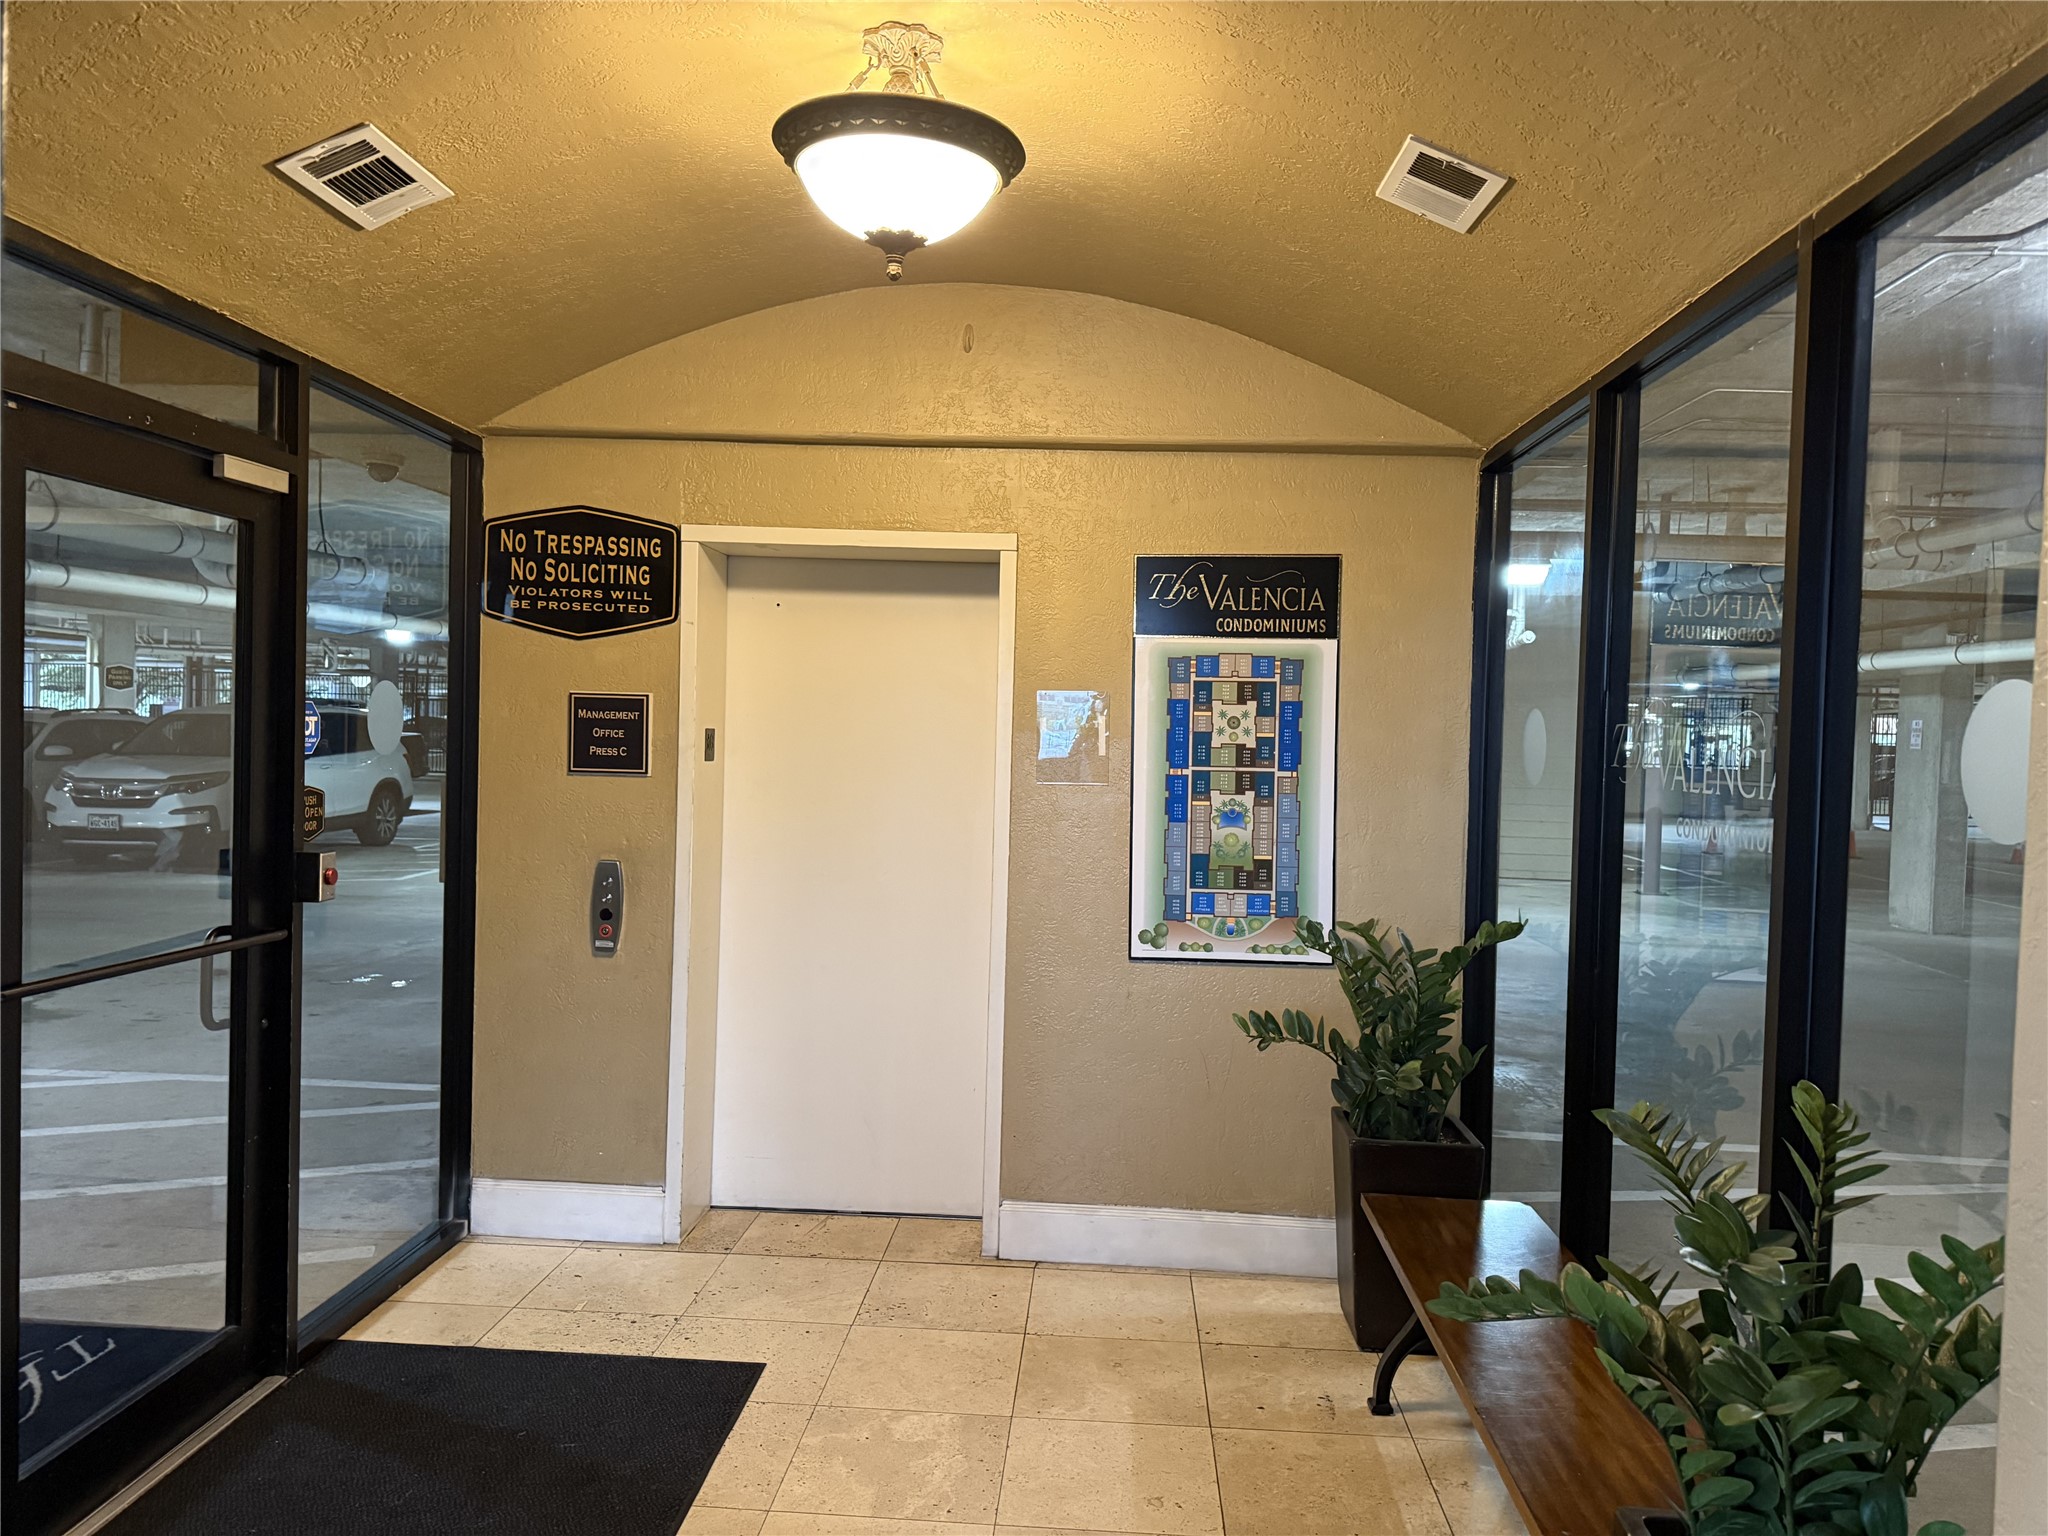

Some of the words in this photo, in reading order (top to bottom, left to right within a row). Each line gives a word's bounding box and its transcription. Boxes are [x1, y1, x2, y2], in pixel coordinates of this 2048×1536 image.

[500, 528, 526, 552] NO
[533, 529, 662, 558] TRESPASSING
[511, 557, 537, 581] NO
[544, 558, 650, 585] SOLICITING
[508, 585, 603, 599] VIOLATORS
[610, 590, 653, 601] WILL
[1148, 562, 1213, 608] The
[1199, 574, 1325, 612] VALENCIA
[510, 600, 531, 609] BE
[537, 601, 650, 614] PROSECUTED
[1216, 617, 1327, 633] CONDOMINIUMS
[578, 709, 640, 720] MANAGEMENT
[592, 727, 625, 738] OFFICE
[589, 746, 618, 756] PRESS
[619, 747, 627, 756] C
